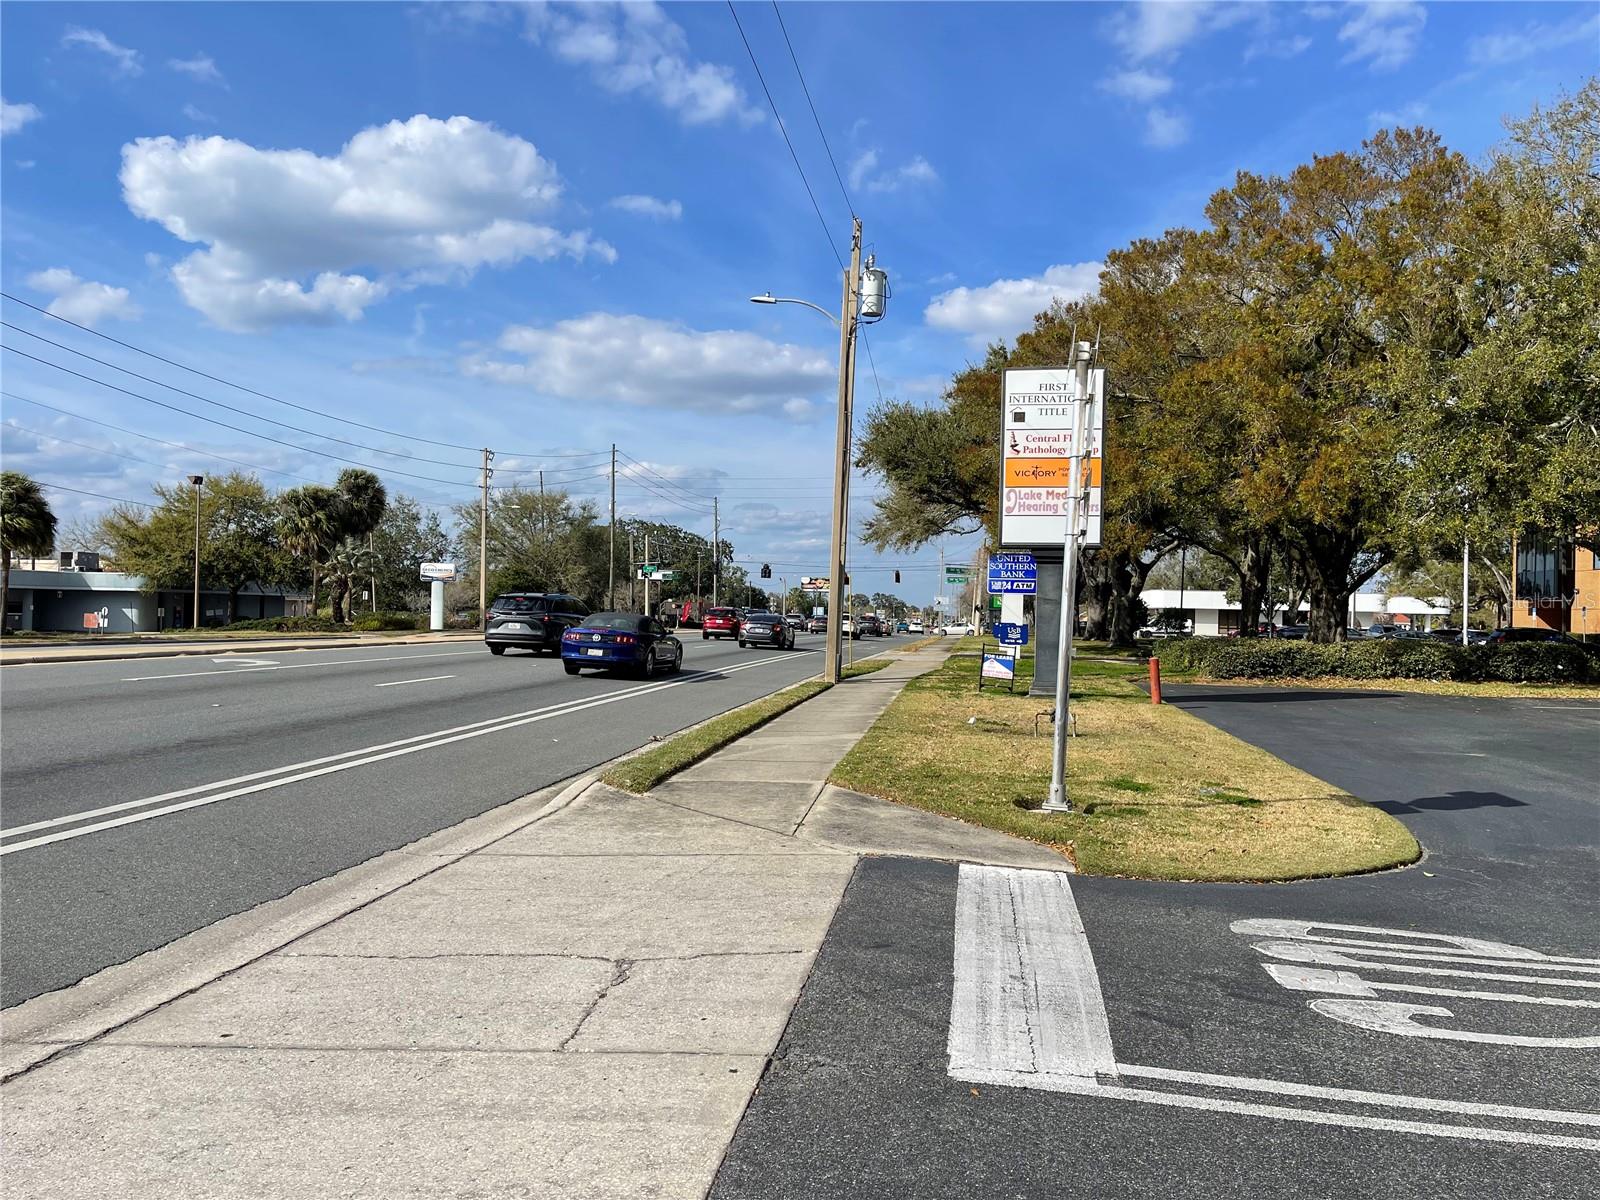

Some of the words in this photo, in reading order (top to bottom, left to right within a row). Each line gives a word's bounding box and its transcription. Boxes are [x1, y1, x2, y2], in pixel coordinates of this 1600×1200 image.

[1039, 383, 1069, 391] FIRST
[1009, 395, 1075, 403] INTERNATIO
[1038, 407, 1068, 416] TITLE
[1025, 434, 1061, 443] Central
[1023, 445, 1067, 456] Pathology
[1018, 489, 1042, 501] Lake
[1018, 502, 1059, 514] Hearing
[997, 554, 1031, 562] UNITED
[989, 562, 1037, 570] SOUTHERN
[1001, 570, 1025, 578] BANK
